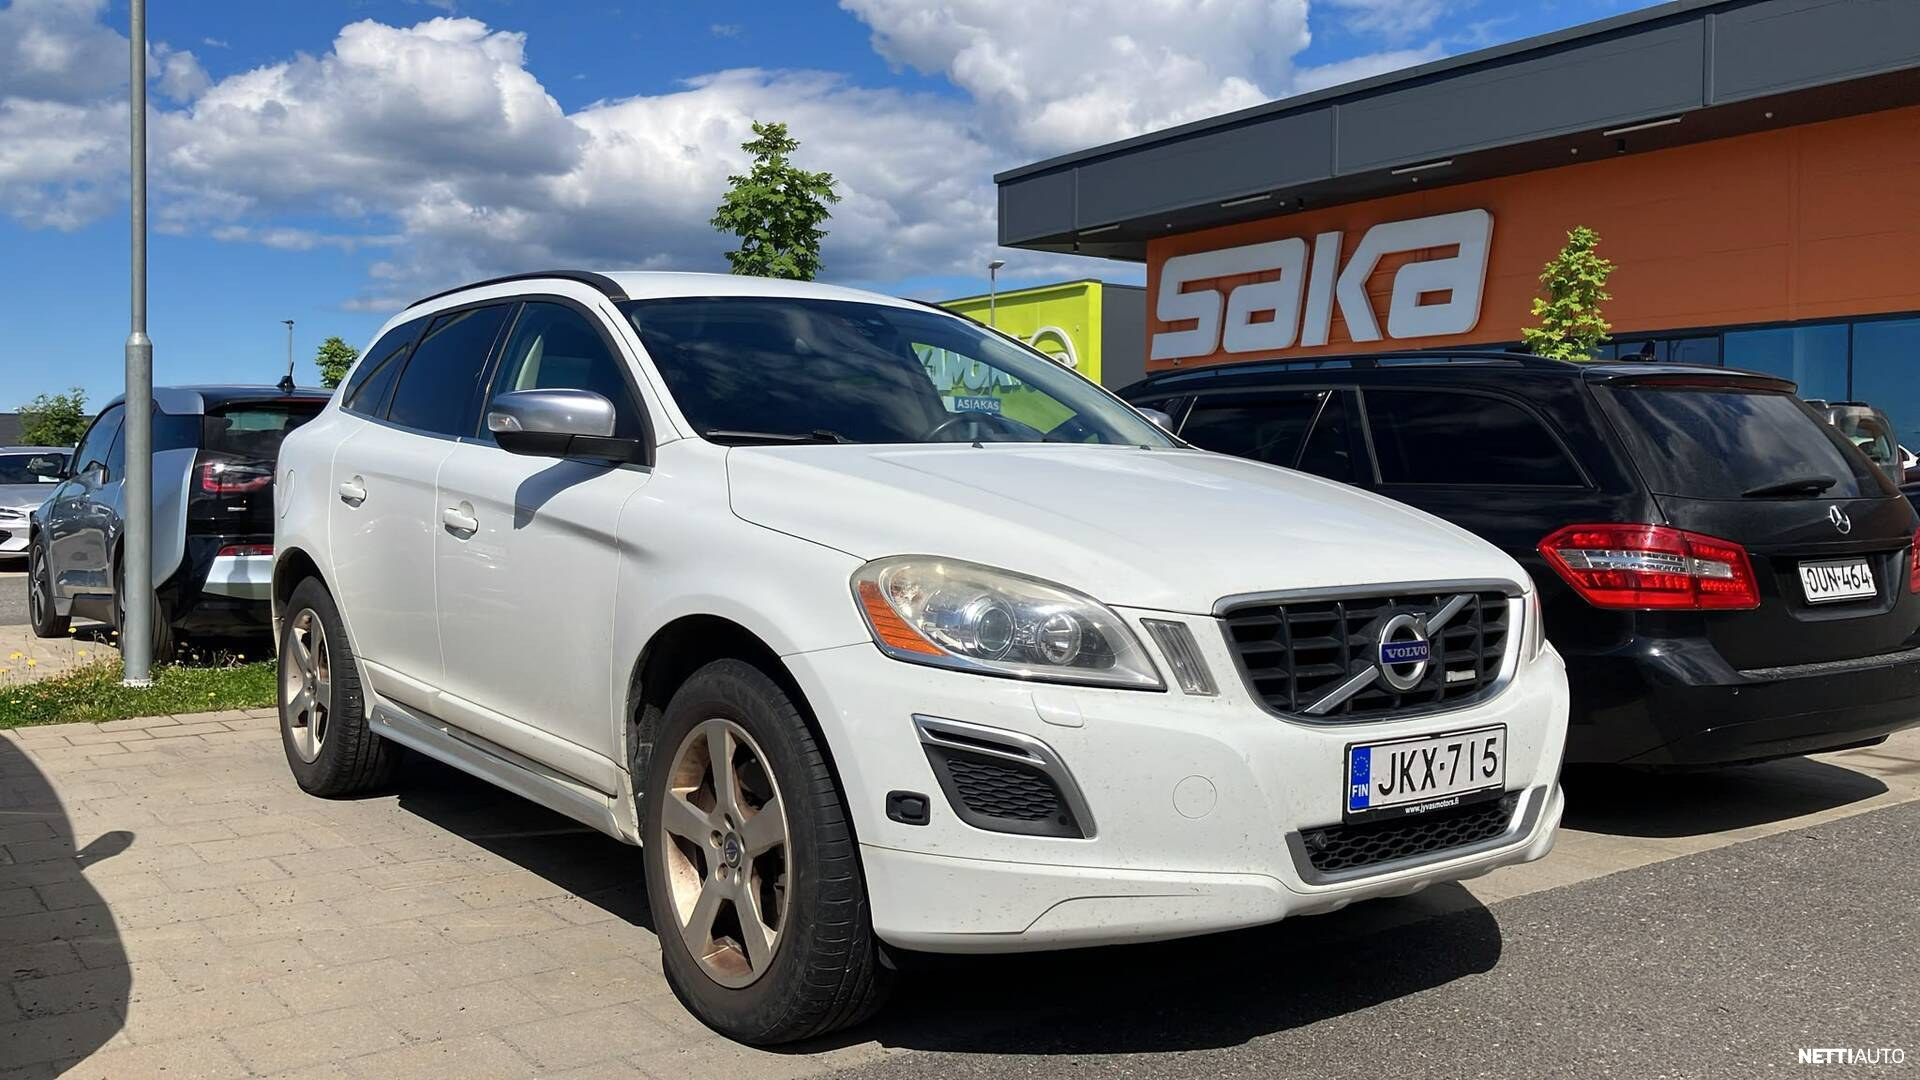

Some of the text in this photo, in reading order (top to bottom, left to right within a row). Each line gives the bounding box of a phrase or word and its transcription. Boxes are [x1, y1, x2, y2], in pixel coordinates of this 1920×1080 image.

[957, 399, 999, 410] ASIAKAS
[1385, 645, 1428, 659] VOLVO
[1378, 737, 1498, 796] JKX-715
[1352, 783, 1369, 798] FIN
